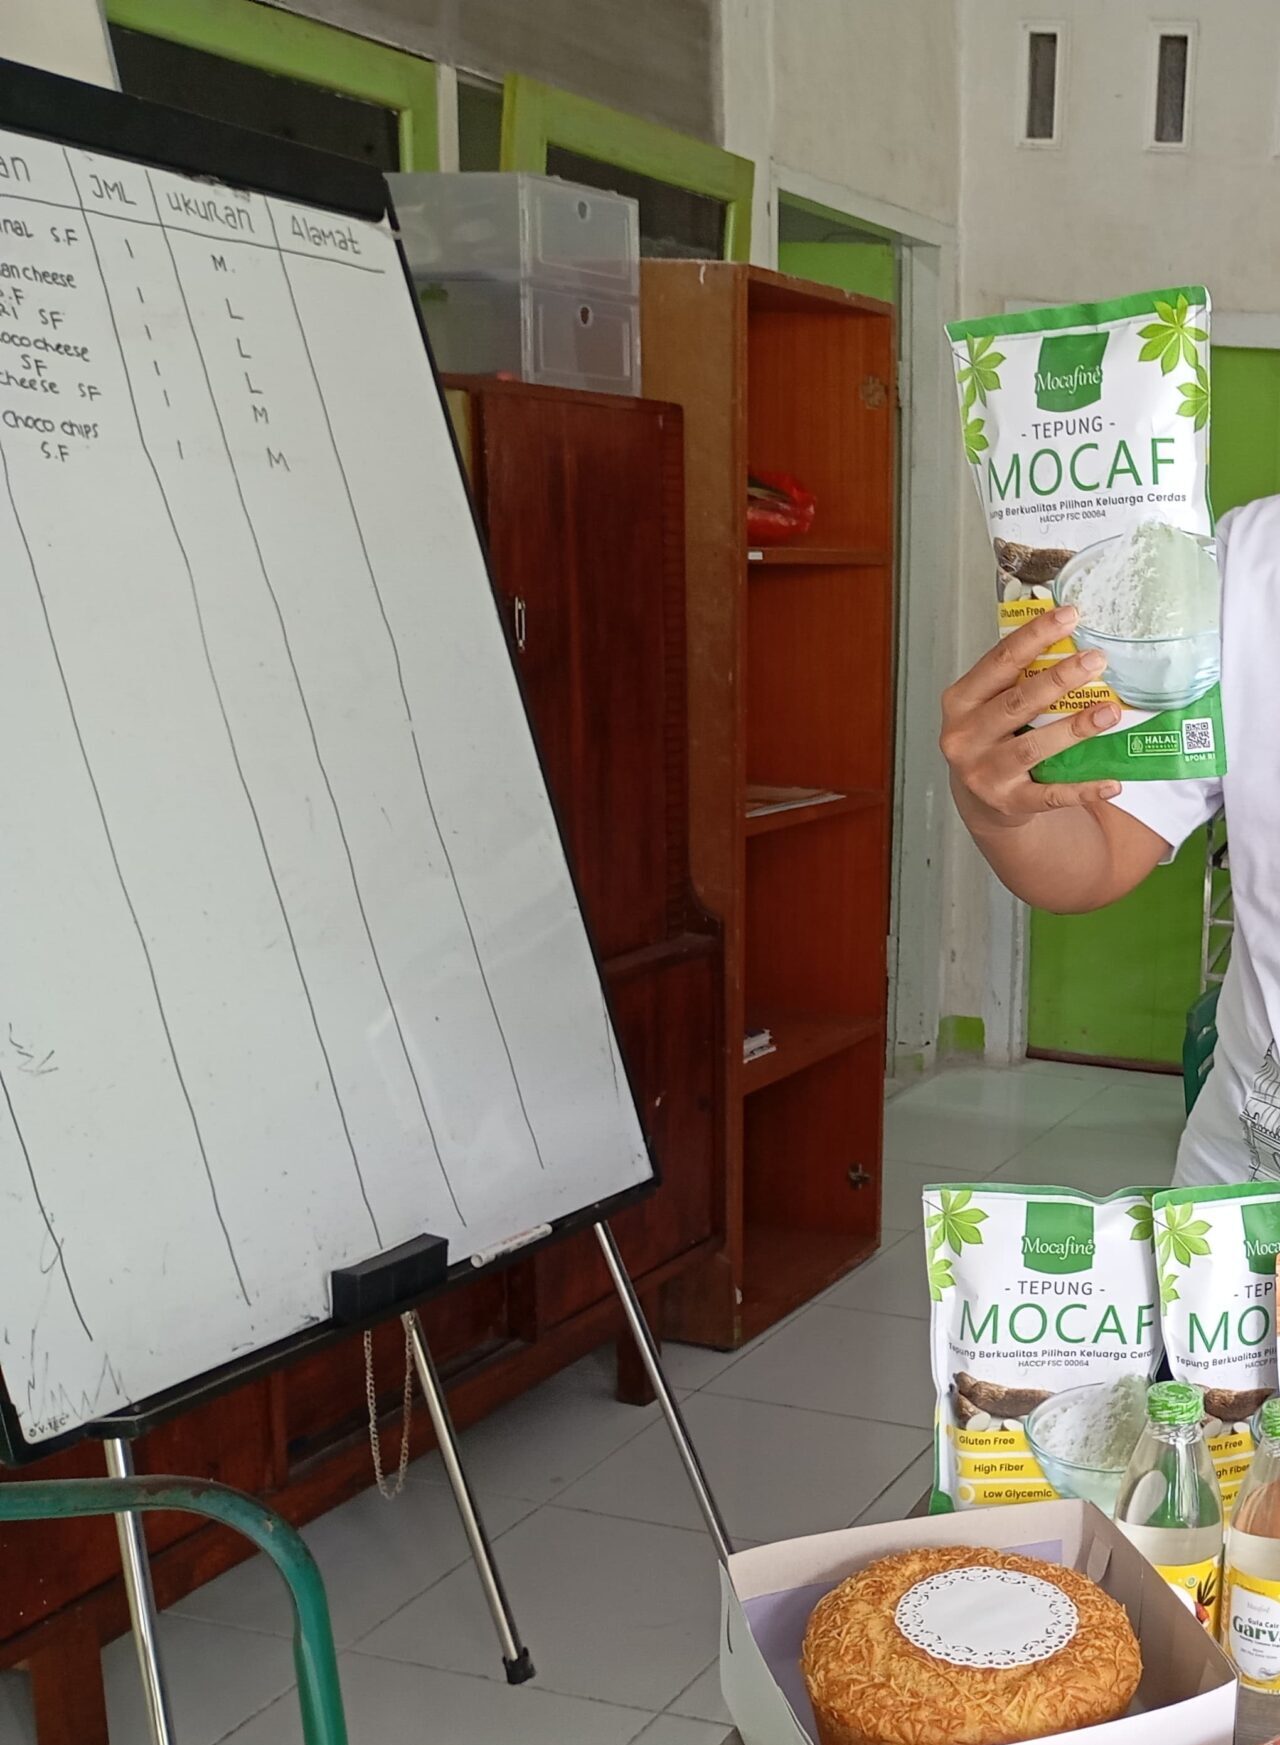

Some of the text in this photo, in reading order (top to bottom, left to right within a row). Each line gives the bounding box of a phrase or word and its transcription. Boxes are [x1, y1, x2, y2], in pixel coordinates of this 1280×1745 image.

[89, 174, 137, 205] JML
[987, 438, 1175, 503] MOCAF
[1005, 502, 1057, 517] Berkualitas
[1059, 498, 1093, 511] Pilihan
[1095, 494, 1144, 508] Keluarga
[1147, 492, 1186, 503] Cerdas
[1026, 606, 1046, 617] Free
[1067, 688, 1110, 700] Calsium
[1144, 735, 1178, 744] HALAL
[959, 1300, 1154, 1345] MOCAF
[979, 1350, 1038, 1360] Berkualitas
[1041, 1349, 1078, 1358] Pilihan
[1080, 1349, 1127, 1361] Keluarga
[1176, 1356, 1209, 1370] Tepung
[1212, 1351, 1261, 1367] Berkualitas
[1018, 1360, 1045, 1368] HACCP
[958, 1435, 1015, 1446] Gluten Free
[1224, 1438, 1243, 1449] Free
[973, 1462, 1024, 1474] High Fiber
[983, 1489, 1052, 1501] Low Glycemic
